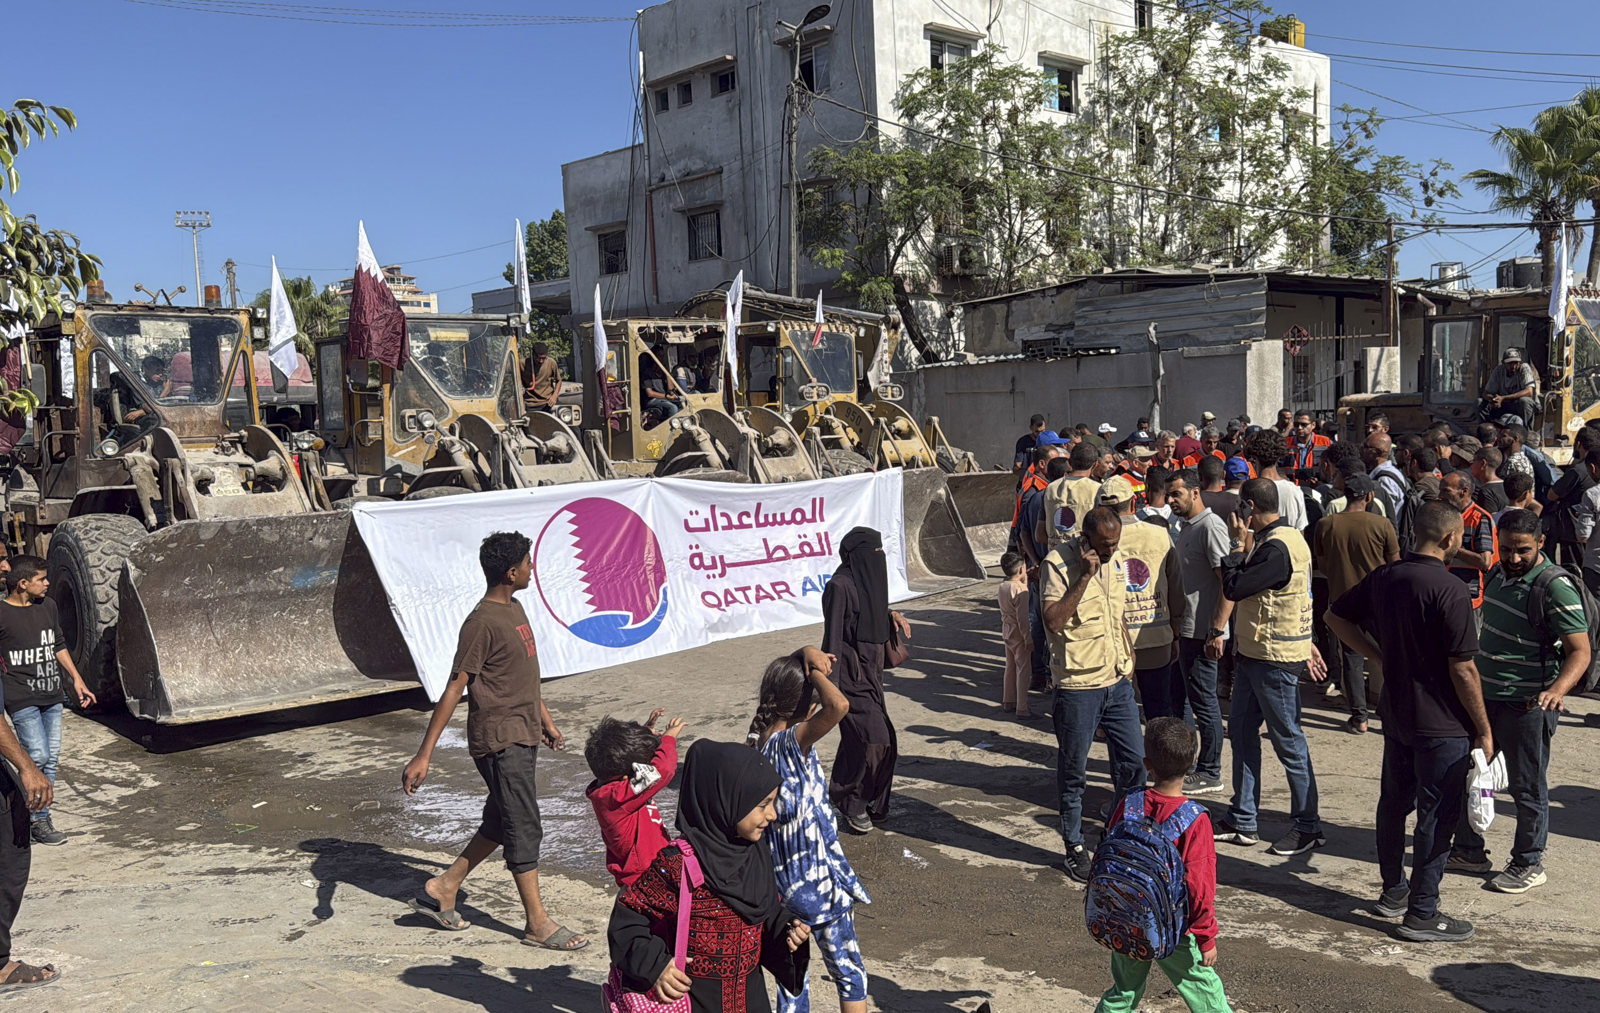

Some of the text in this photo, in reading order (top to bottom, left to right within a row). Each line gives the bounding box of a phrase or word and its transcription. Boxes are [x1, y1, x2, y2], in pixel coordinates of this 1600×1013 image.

[683, 497, 825, 533] المساعدات
[688, 531, 833, 580] القطرية
[700, 580, 797, 612] QATAR
[9, 645, 56, 666] WHERE
[36, 661, 59, 678] ARE
